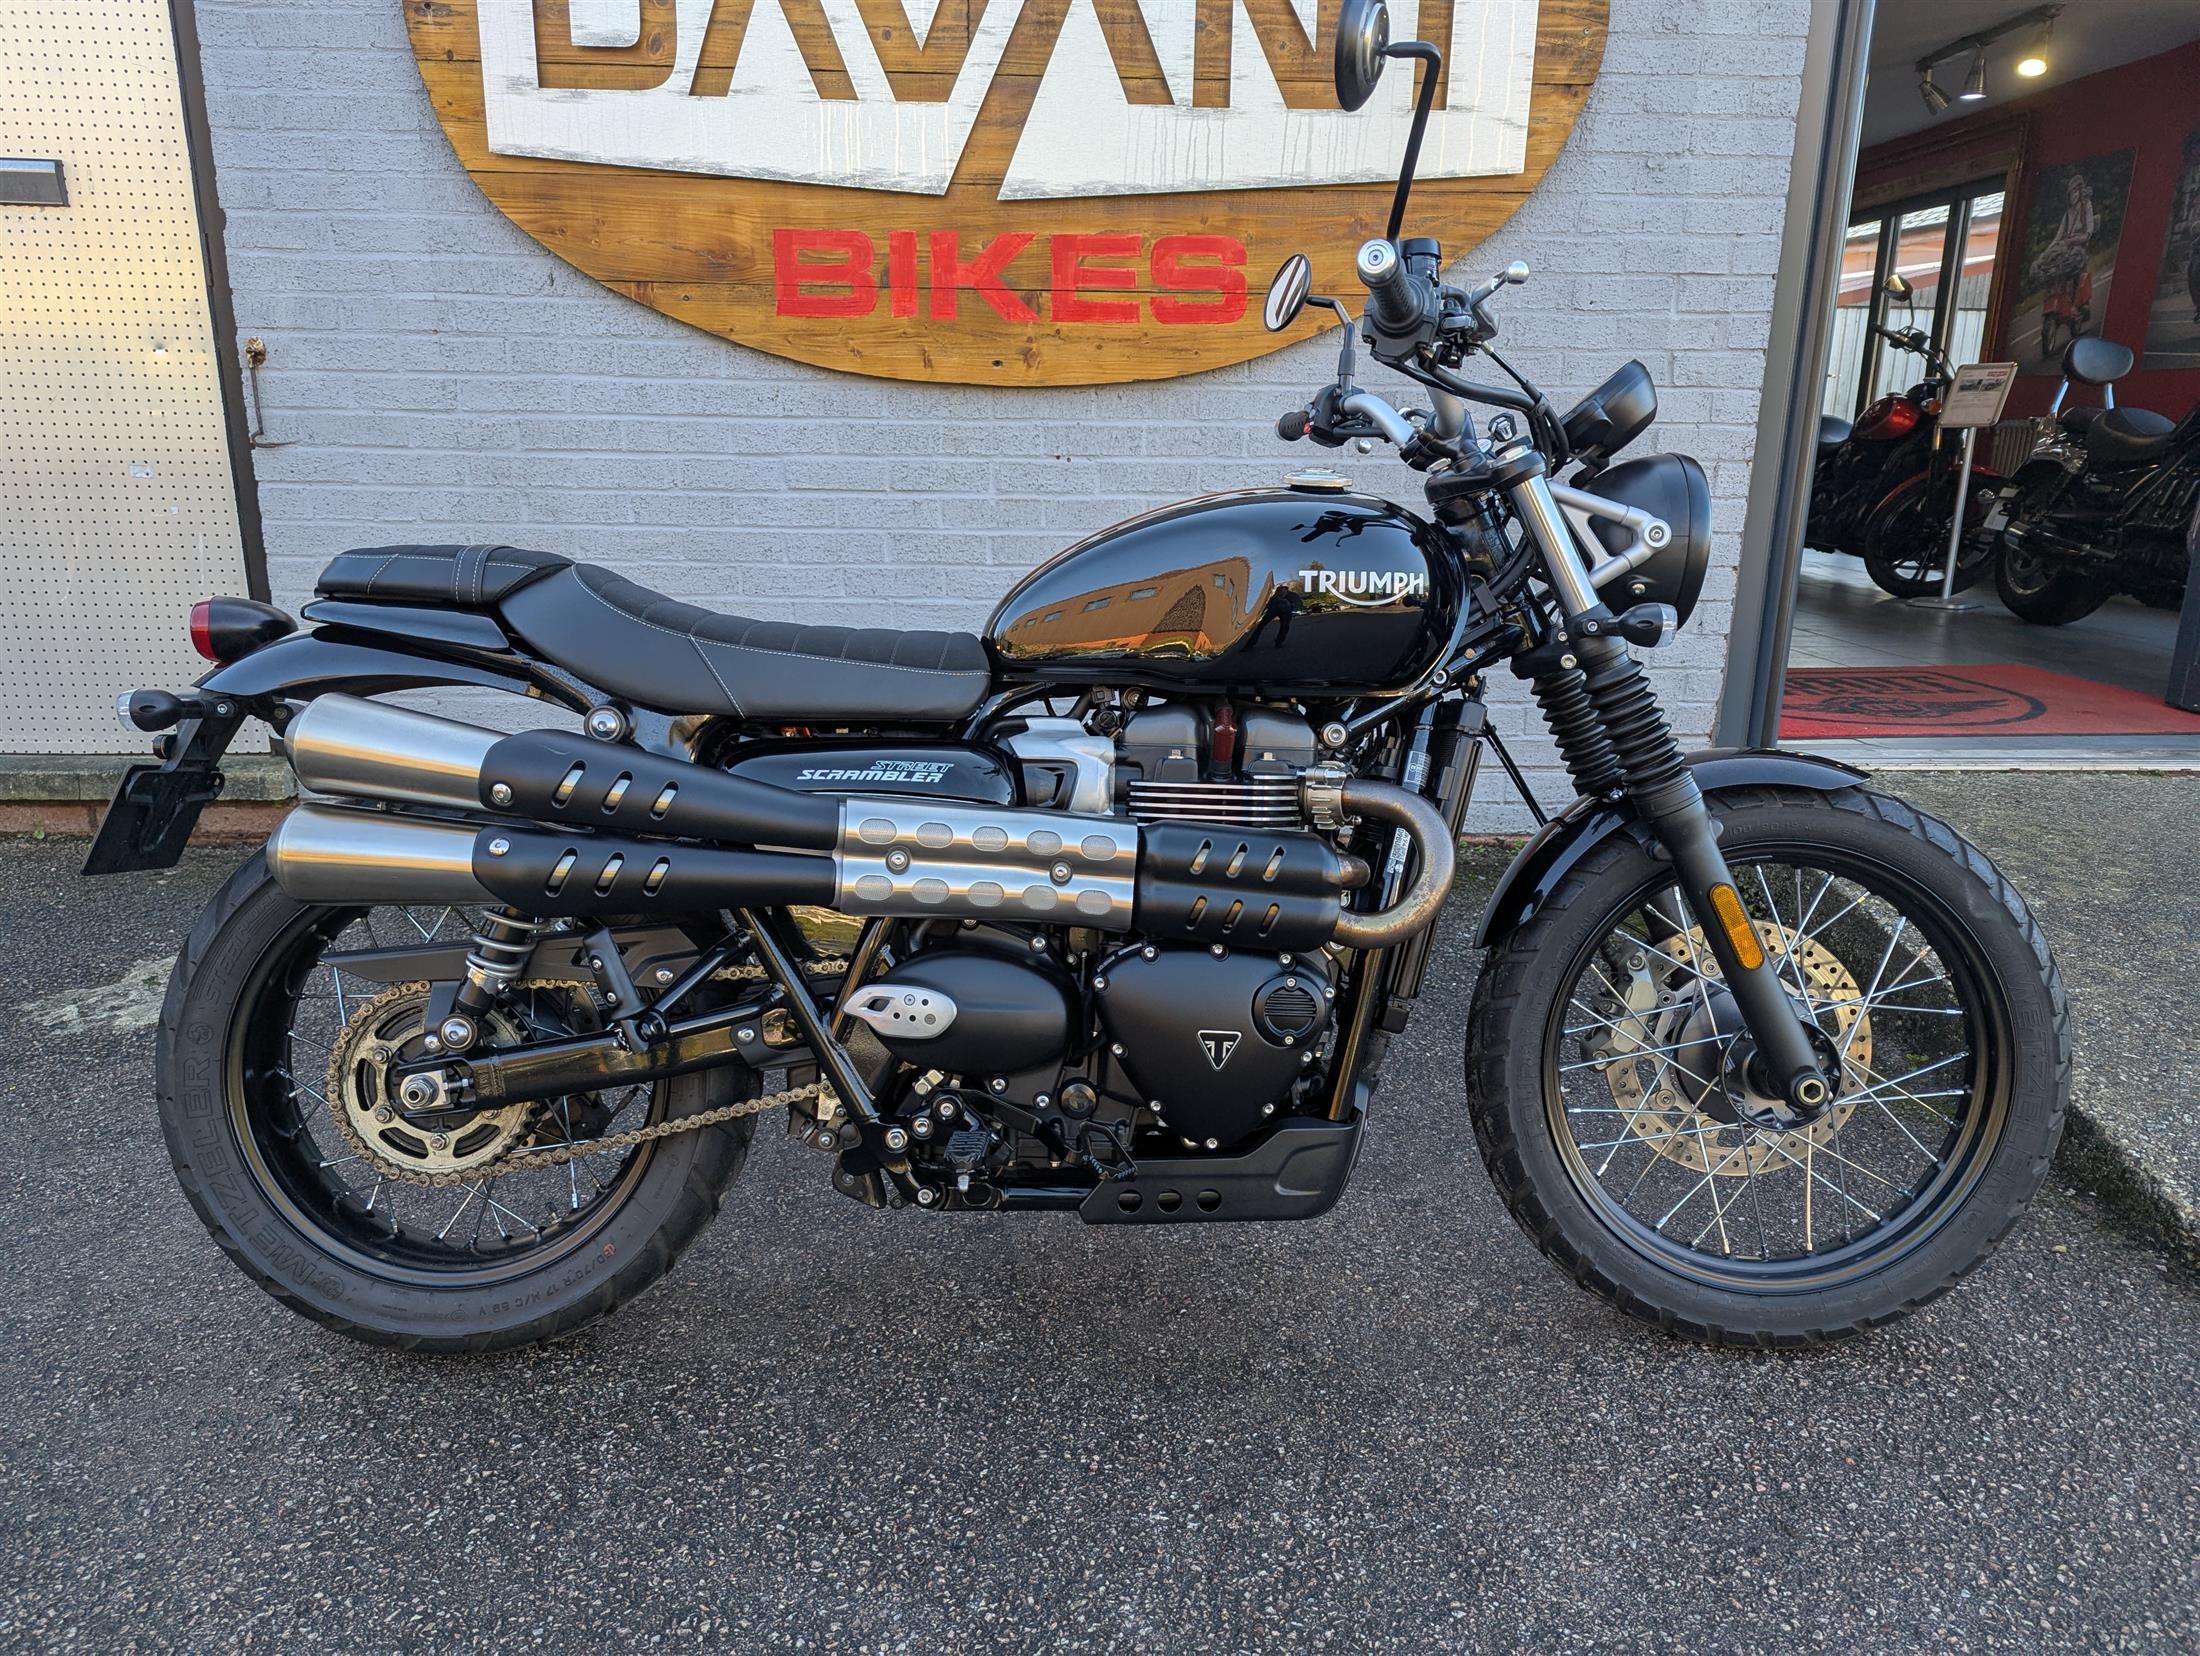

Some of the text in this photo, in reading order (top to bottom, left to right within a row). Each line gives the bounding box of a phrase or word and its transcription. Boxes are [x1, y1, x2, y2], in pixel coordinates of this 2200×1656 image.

[773, 229, 1248, 325] BIKES
[1299, 570, 1424, 605] TRIUMPH
[797, 769, 944, 783] SCRAMBLER
[870, 760, 954, 773] STREET
[184, 1057, 318, 1286] METZELER
